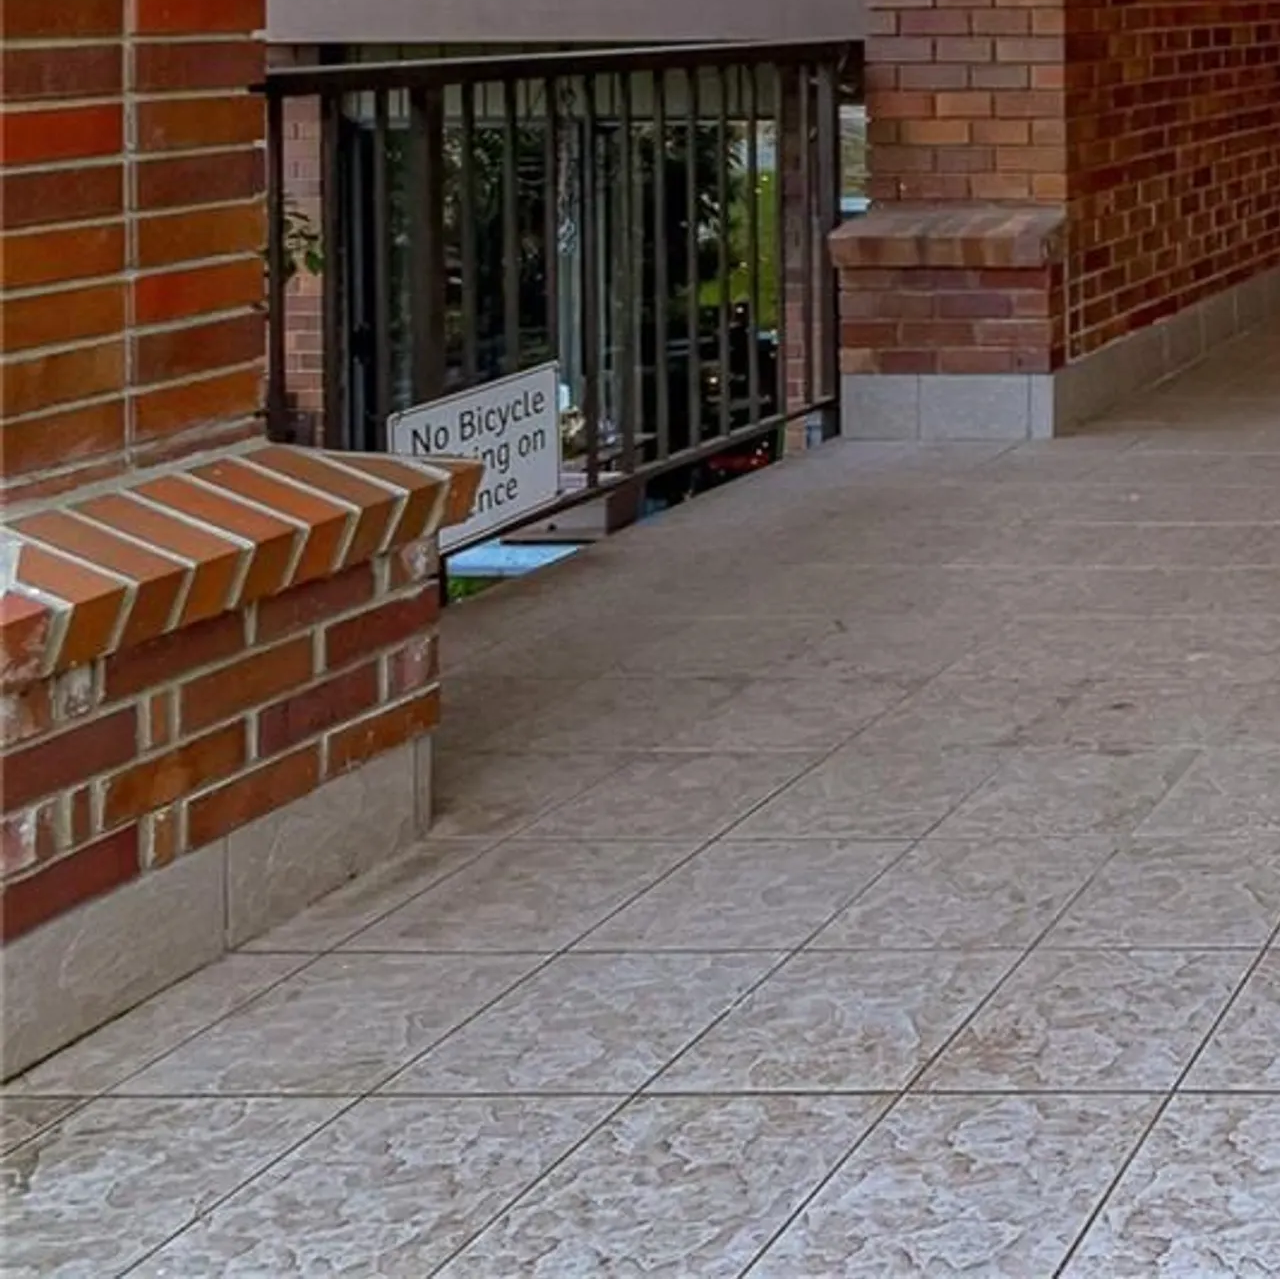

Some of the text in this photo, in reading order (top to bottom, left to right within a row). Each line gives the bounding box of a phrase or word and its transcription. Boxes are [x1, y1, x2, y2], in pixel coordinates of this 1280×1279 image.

[411, 391, 545, 455] No Bicycle
[518, 428, 546, 457] on
[477, 476, 518, 512] nce
